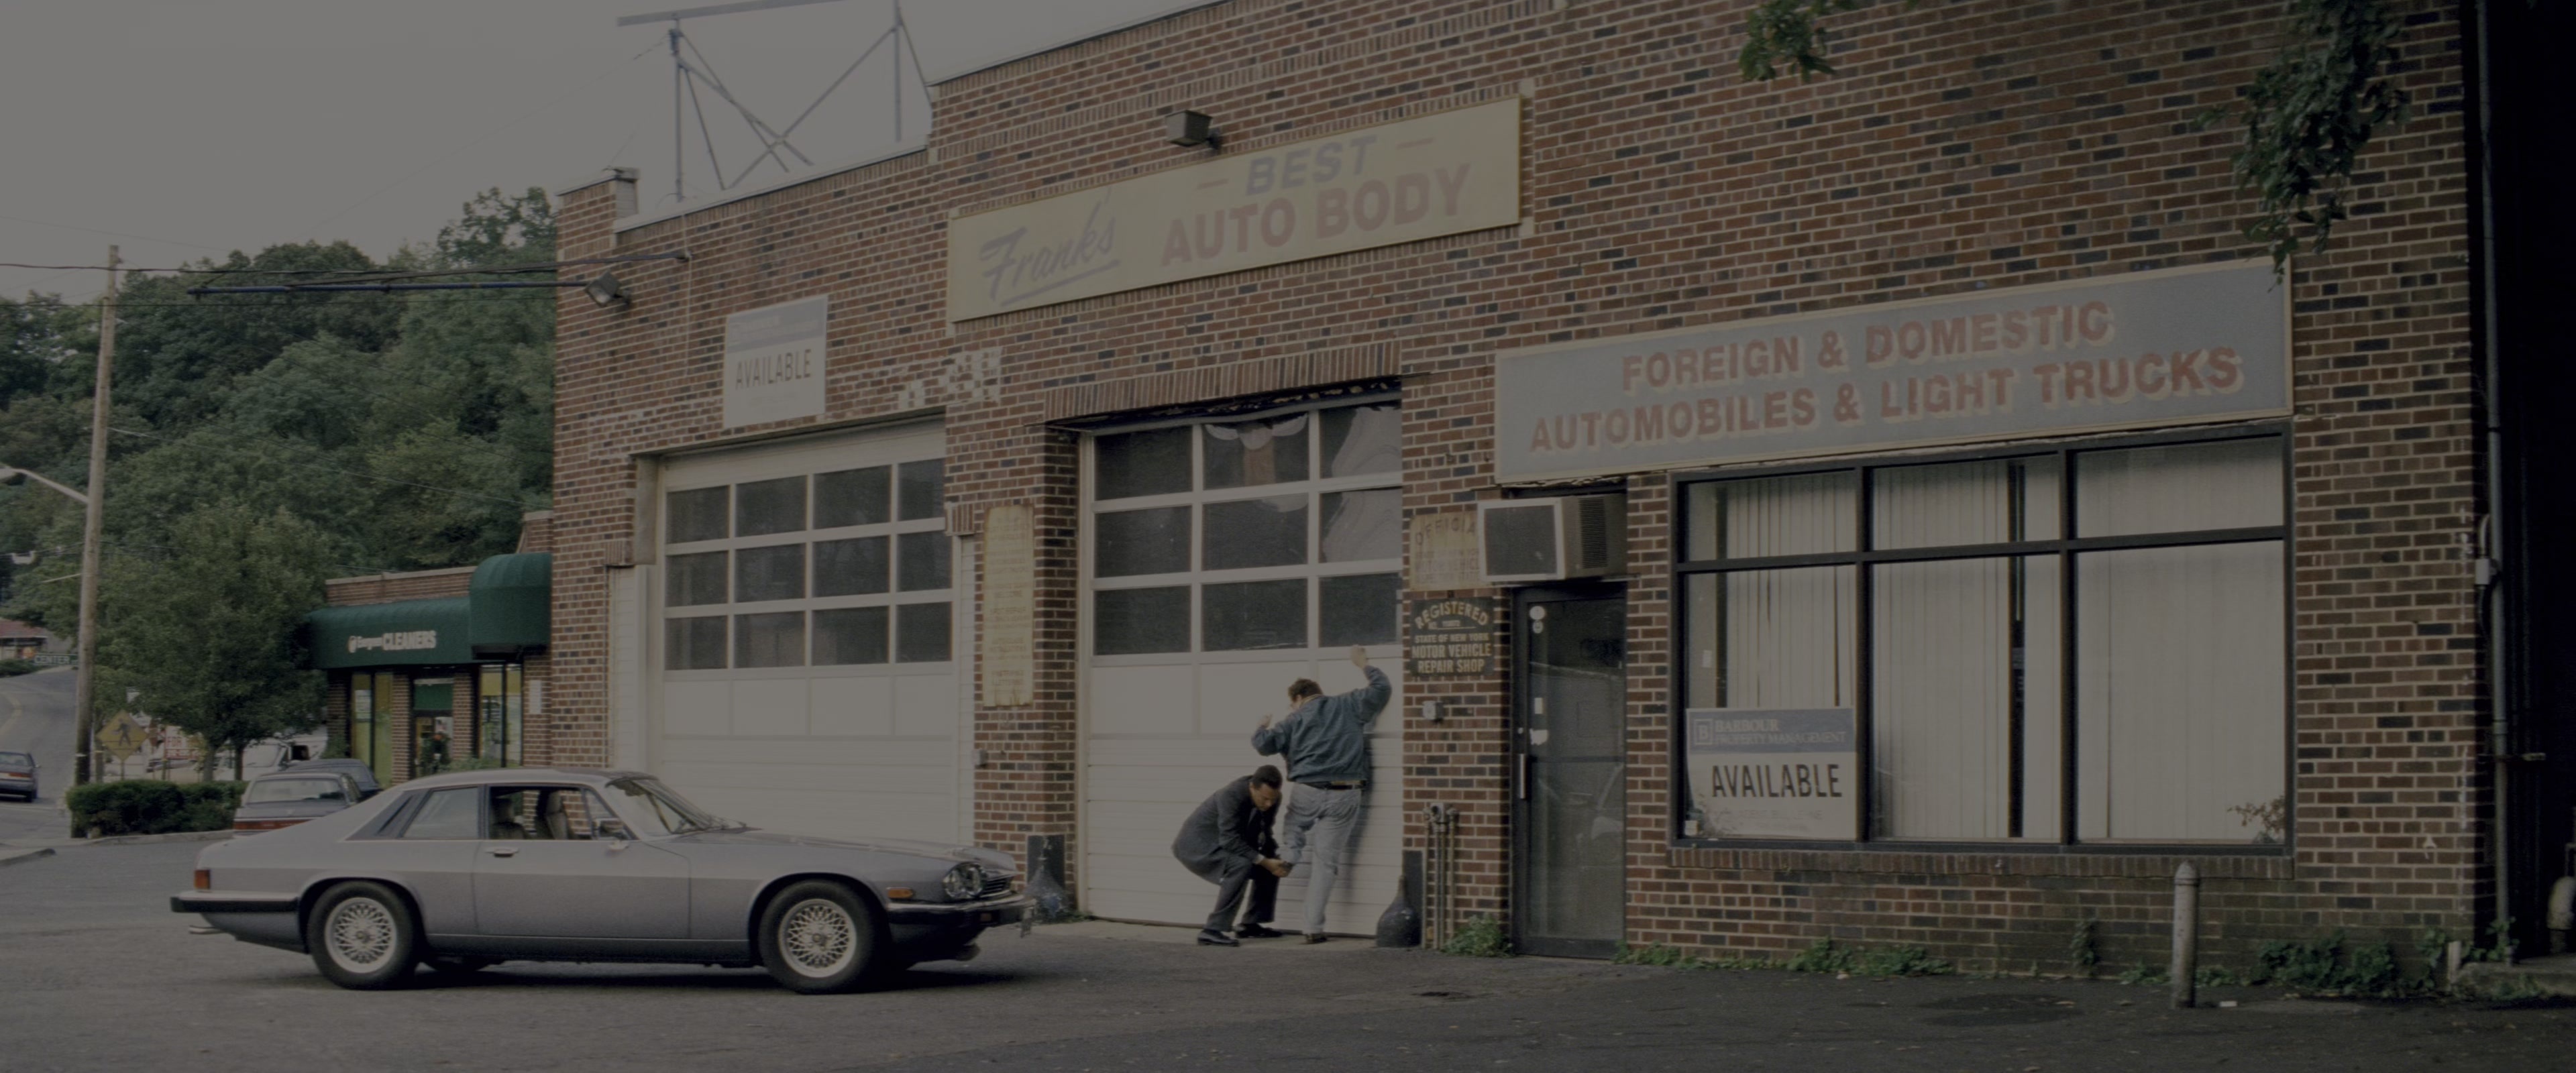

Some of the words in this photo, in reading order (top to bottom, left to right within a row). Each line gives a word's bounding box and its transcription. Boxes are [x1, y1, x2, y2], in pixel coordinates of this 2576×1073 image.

[1246, 135, 1377, 196] BEST
[1161, 197, 1296, 267] AUTO
[1315, 163, 1471, 239] BODY
[979, 186, 1116, 301] Frank's
[1622, 335, 1801, 393] FOREIGN
[1817, 330, 1846, 370] &
[1865, 300, 2112, 364] DOMESTIC
[735, 349, 812, 390] AVAILABLE
[1529, 388, 1817, 453] AUTOMOBILES
[1833, 382, 1862, 422] &
[1881, 368, 2015, 418] LIGHT
[2034, 347, 2239, 403] TRUCKS
[1415, 516, 1476, 545] OFFICIA
[1415, 601, 1489, 629] REGISTERED
[382, 630, 436, 651] CLEANERS
[1412, 645, 1446, 659] MOTOR
[1448, 643, 1492, 657] VEHICLE
[1415, 635, 1437, 643] STATE
[1438, 634, 1448, 642] OF
[1450, 634, 1467, 642] NEW
[1417, 659, 1454, 673] REPAIR
[1456, 659, 1485, 673] SHOP
[1715, 719, 1780, 733] BARBOUR
[1767, 732, 1846, 744] MANAGEMENT
[1712, 765, 1842, 797] AVAILABLE
